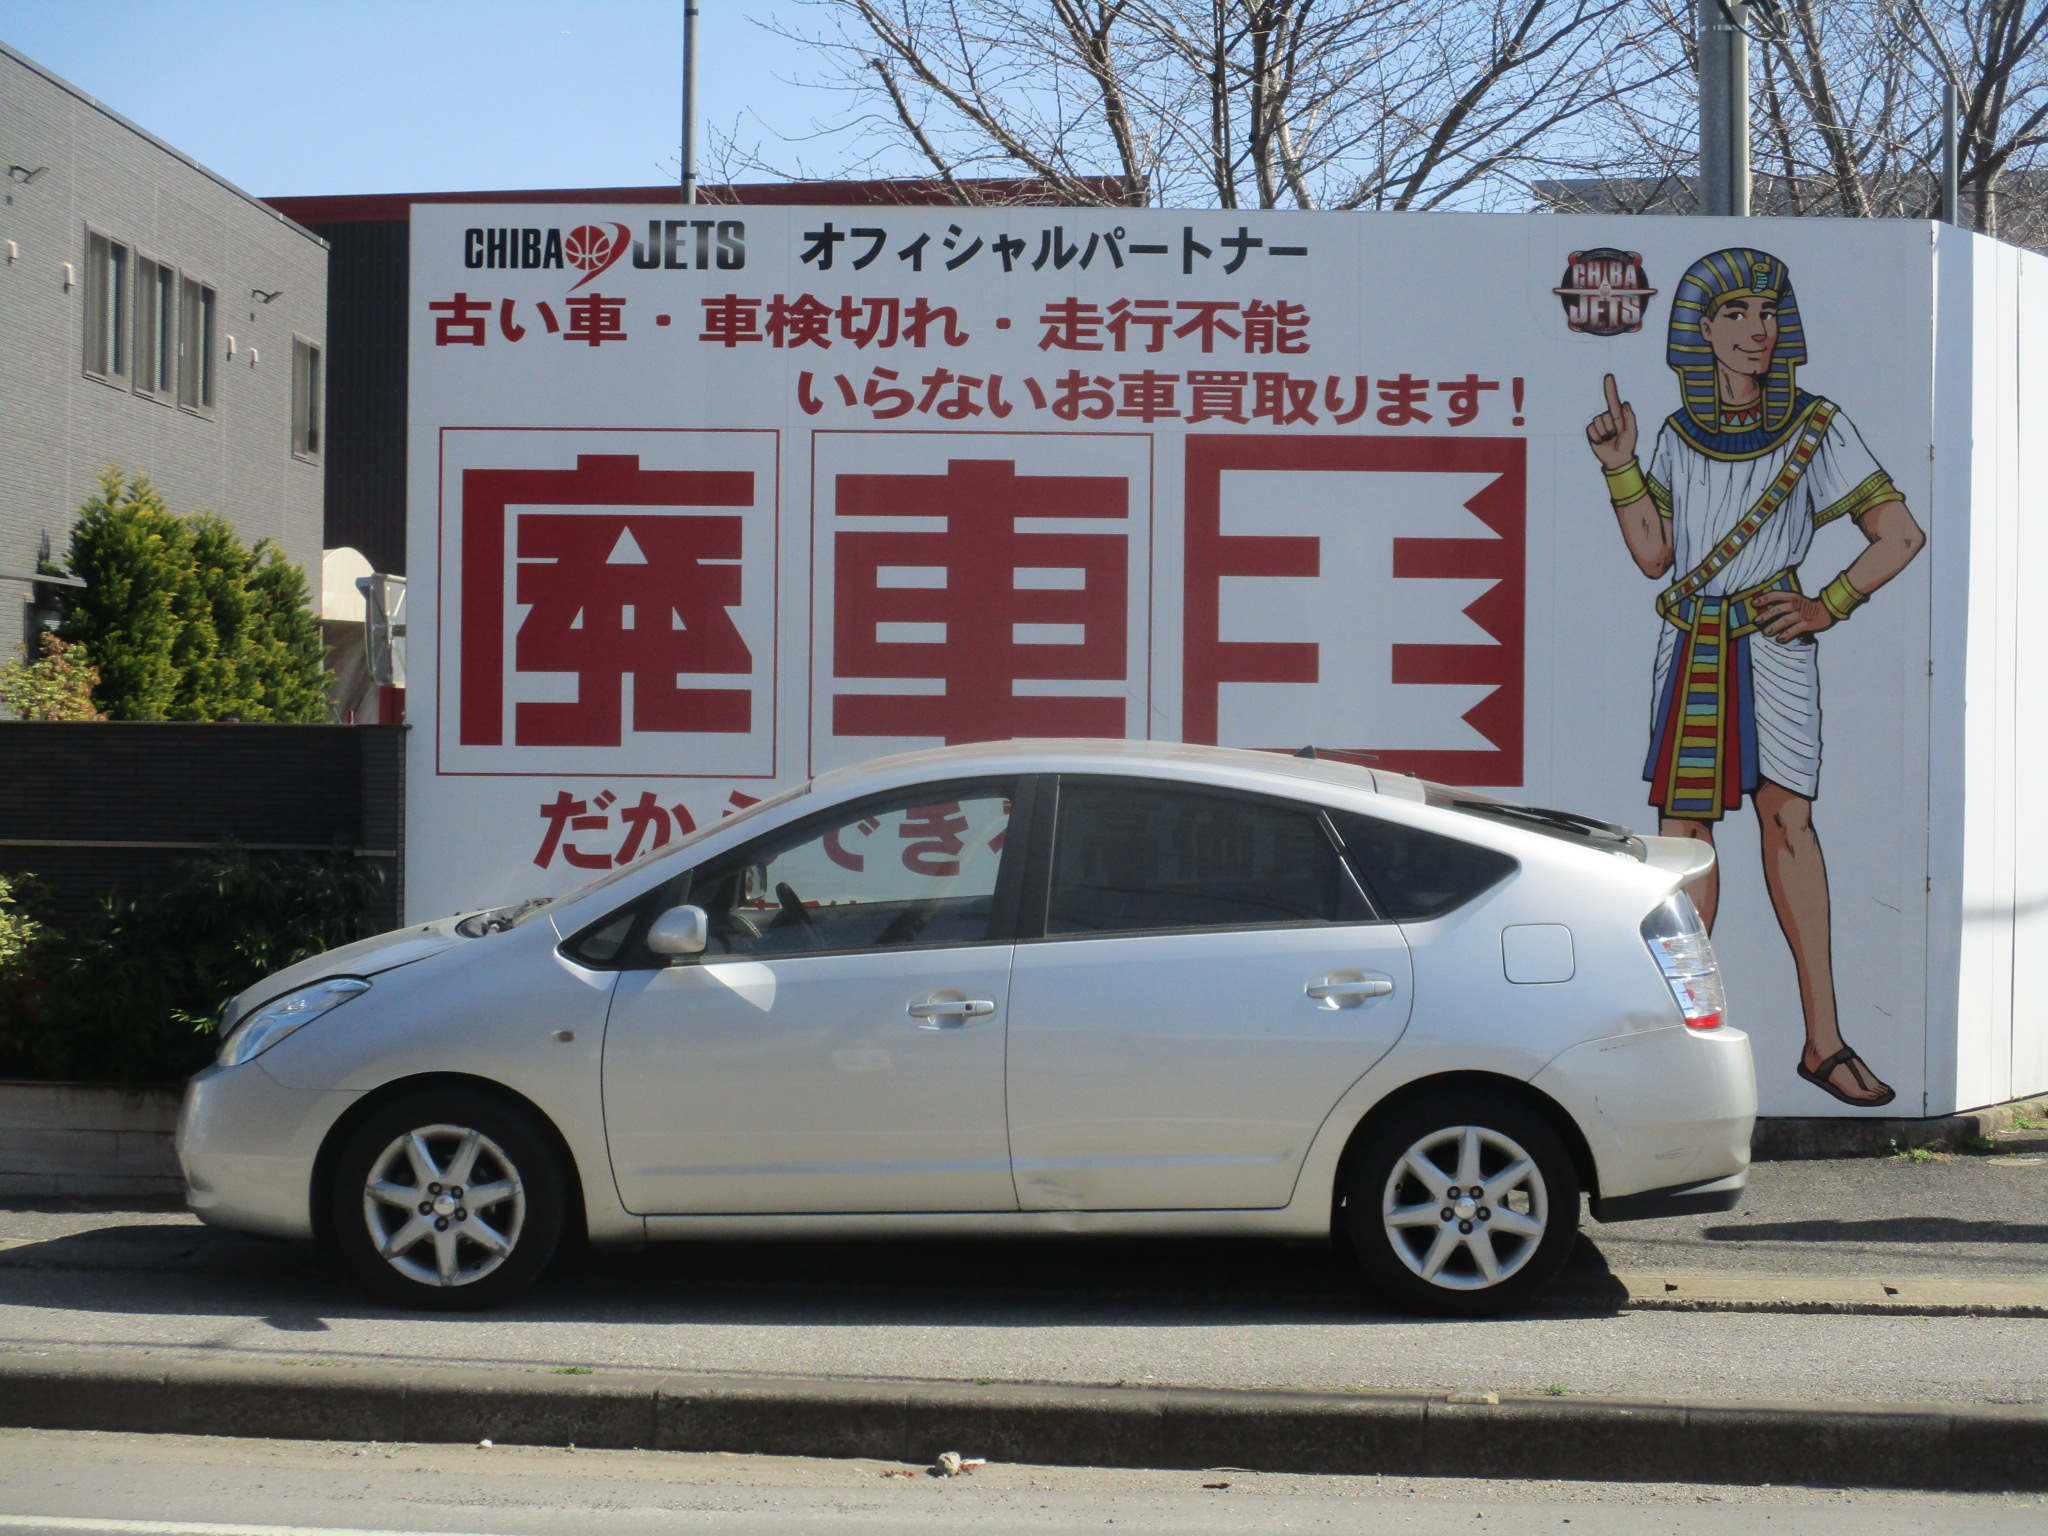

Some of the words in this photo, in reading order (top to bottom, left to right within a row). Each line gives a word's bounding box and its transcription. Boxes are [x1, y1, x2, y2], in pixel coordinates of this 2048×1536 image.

[464, 228, 564, 269] CHIBA
[632, 220, 746, 270] JETS
[800, 222, 1309, 275] オフィシャルパートナー
[1572, 259, 1638, 288] CHIBA
[429, 293, 1312, 355] 古い車・車検切れ・走行不能
[1569, 294, 1641, 327] JETS
[798, 366, 1525, 426] いらないお車買取ります!
